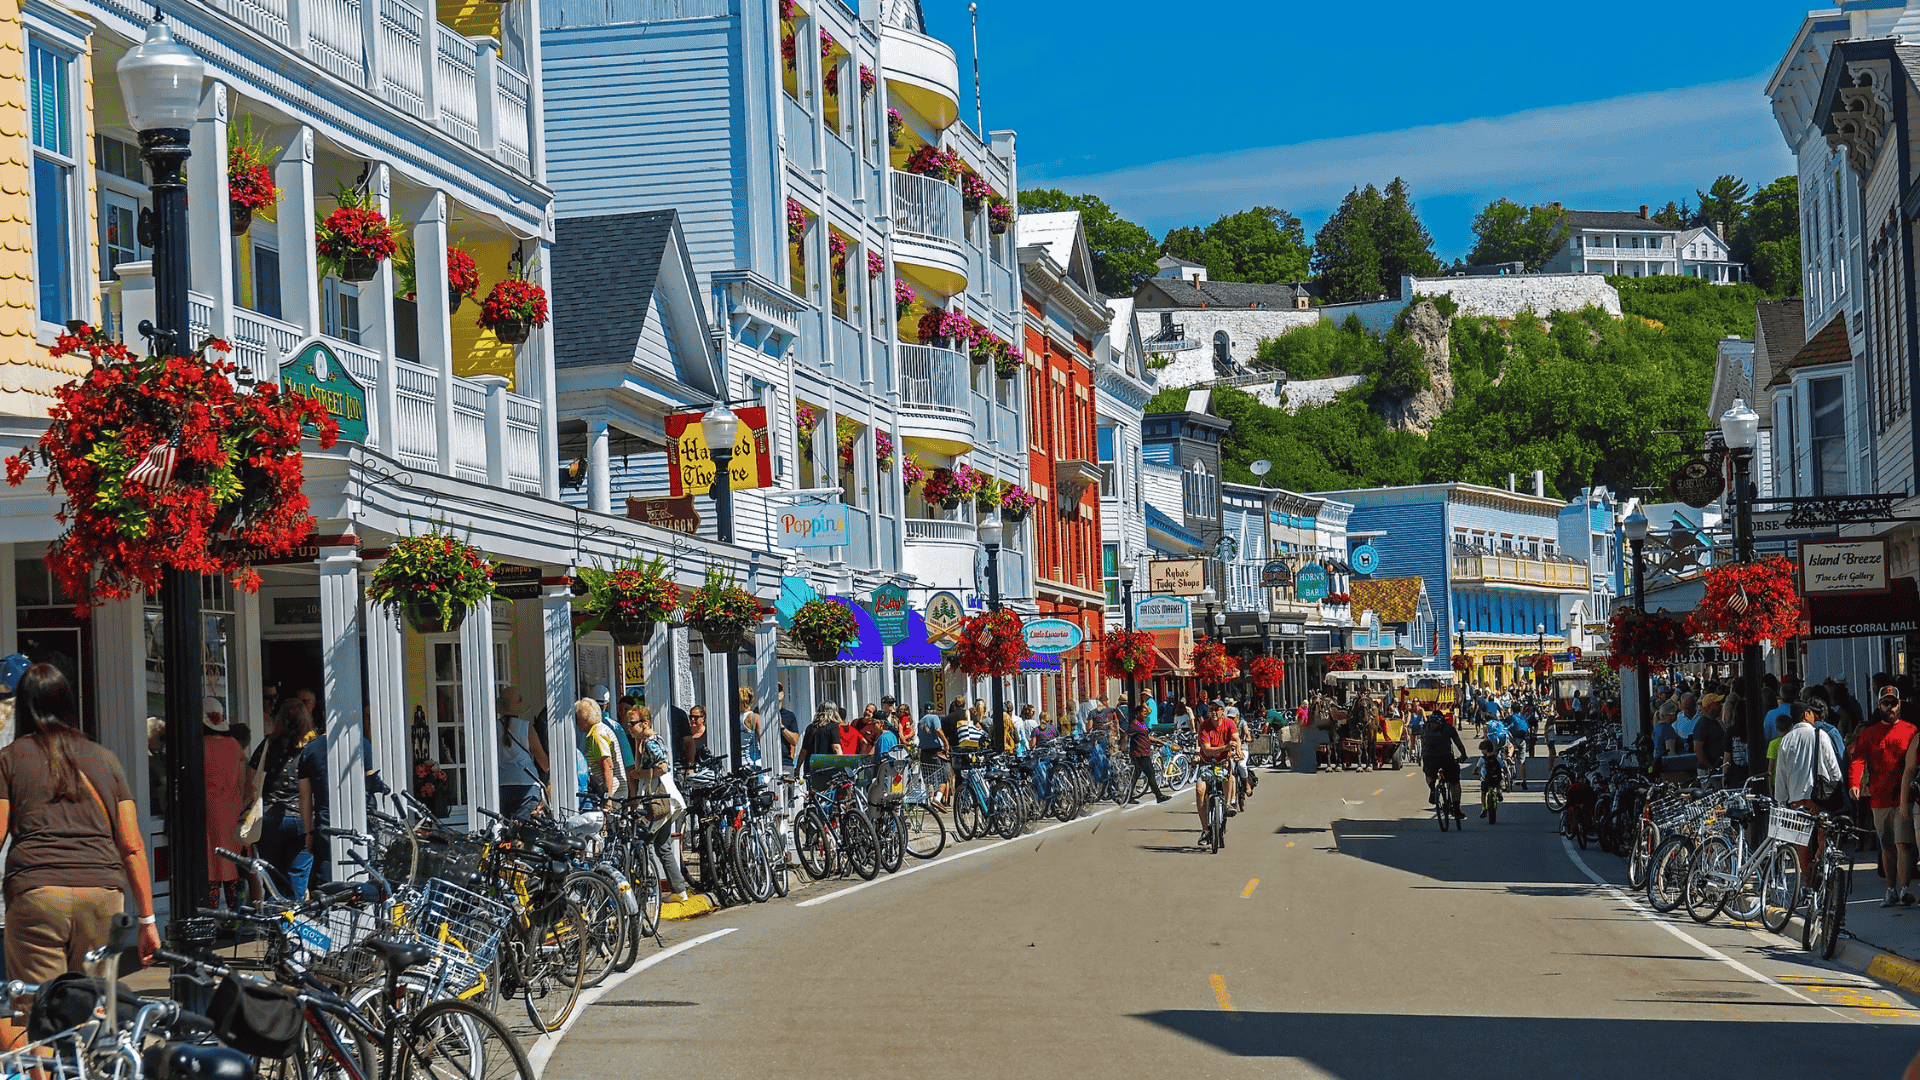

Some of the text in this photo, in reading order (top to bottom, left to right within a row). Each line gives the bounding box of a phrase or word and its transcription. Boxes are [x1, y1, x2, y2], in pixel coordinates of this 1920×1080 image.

[310, 383, 343, 416] STREET
[345, 391, 361, 420] INN
[680, 435, 751, 462] Haed
[682, 464, 749, 487] There
[780, 513, 844, 539] Poppins
[1751, 520, 1780, 532] ORSE
[222, 545, 319, 562] OANN'S FUD
[1808, 552, 1882, 567] Island Breeze
[1165, 567, 1189, 579] Ryba's
[1299, 573, 1325, 582] HORN'S
[1815, 571, 1875, 584] Fine Art Gallery
[1177, 578, 1200, 589] Shops
[1305, 588, 1320, 597] BAR
[874, 594, 905, 614] Betty's
[1161, 604, 1184, 615] MARKET
[1814, 620, 1918, 635] HORSE CORRAL MALL
[302, 927, 324, 946] crazy
